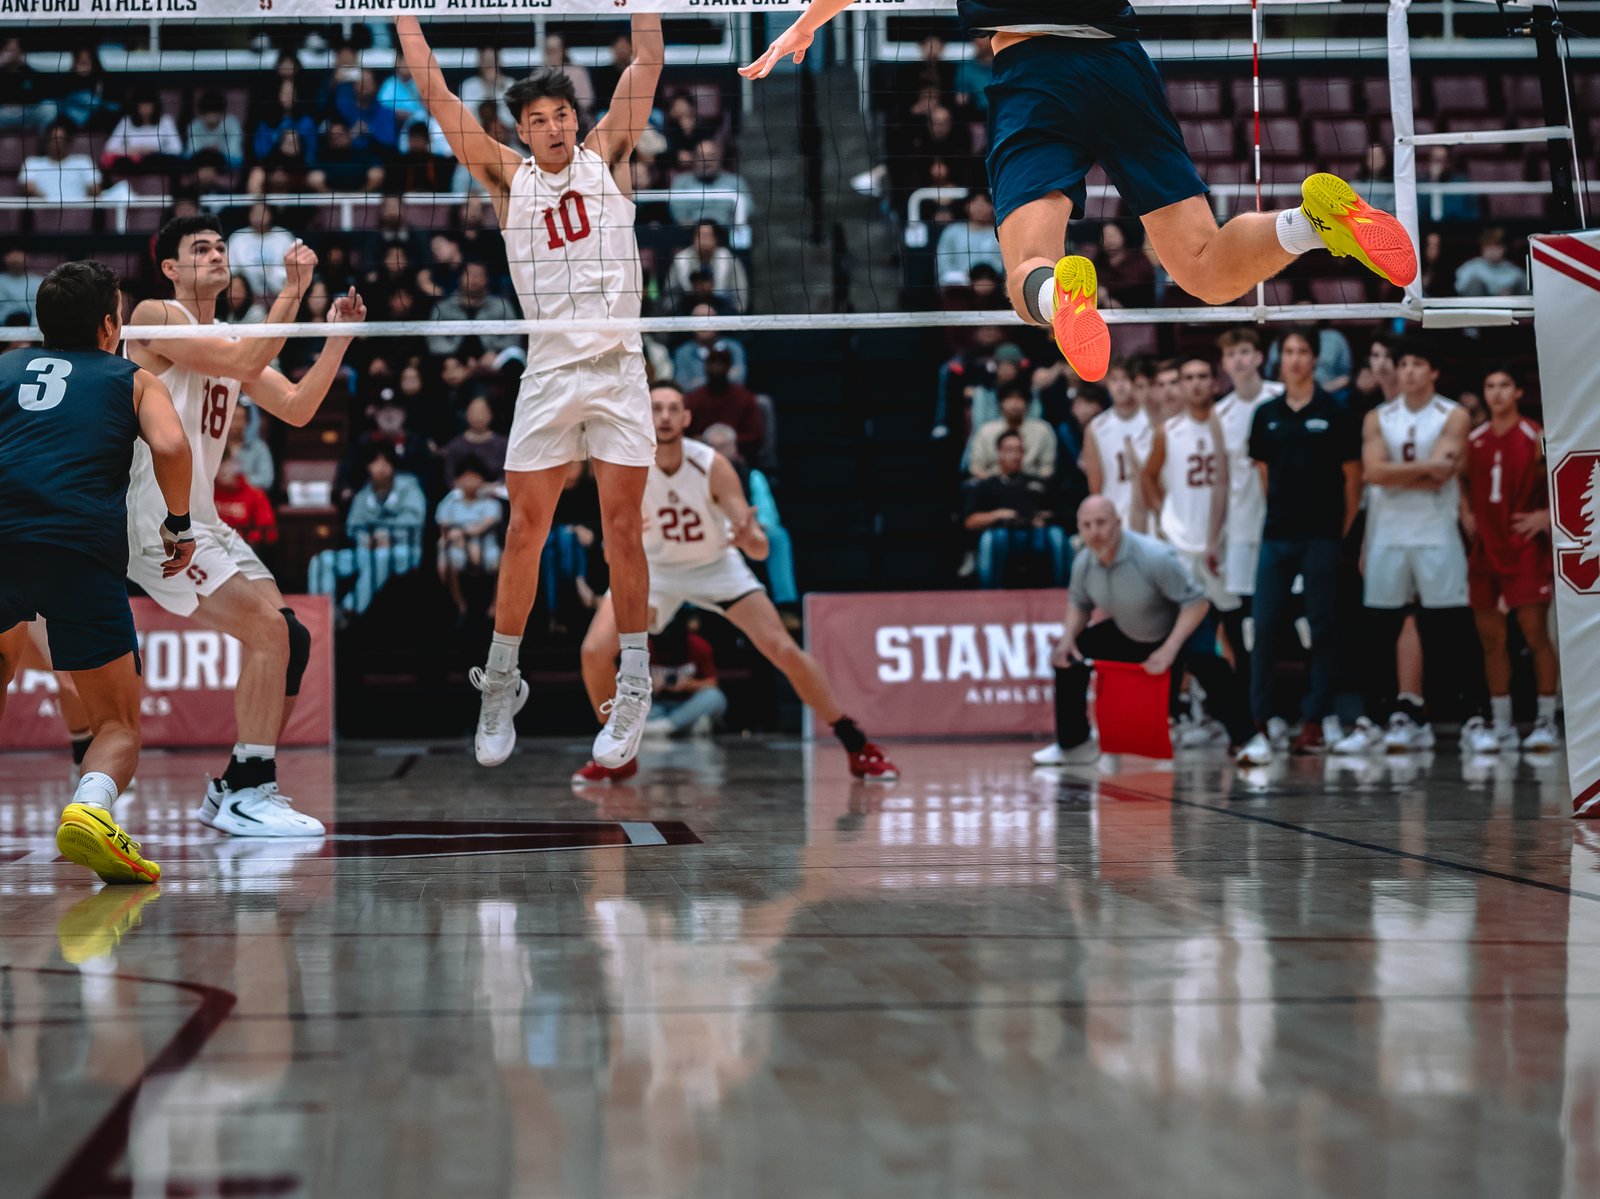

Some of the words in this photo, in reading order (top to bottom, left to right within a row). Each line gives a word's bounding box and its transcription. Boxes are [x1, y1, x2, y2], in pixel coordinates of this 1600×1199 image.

[541, 190, 591, 250] 10
[18, 357, 73, 411] 3
[201, 377, 230, 439] 18
[1489, 465, 1502, 503] 1
[658, 506, 704, 543] 22
